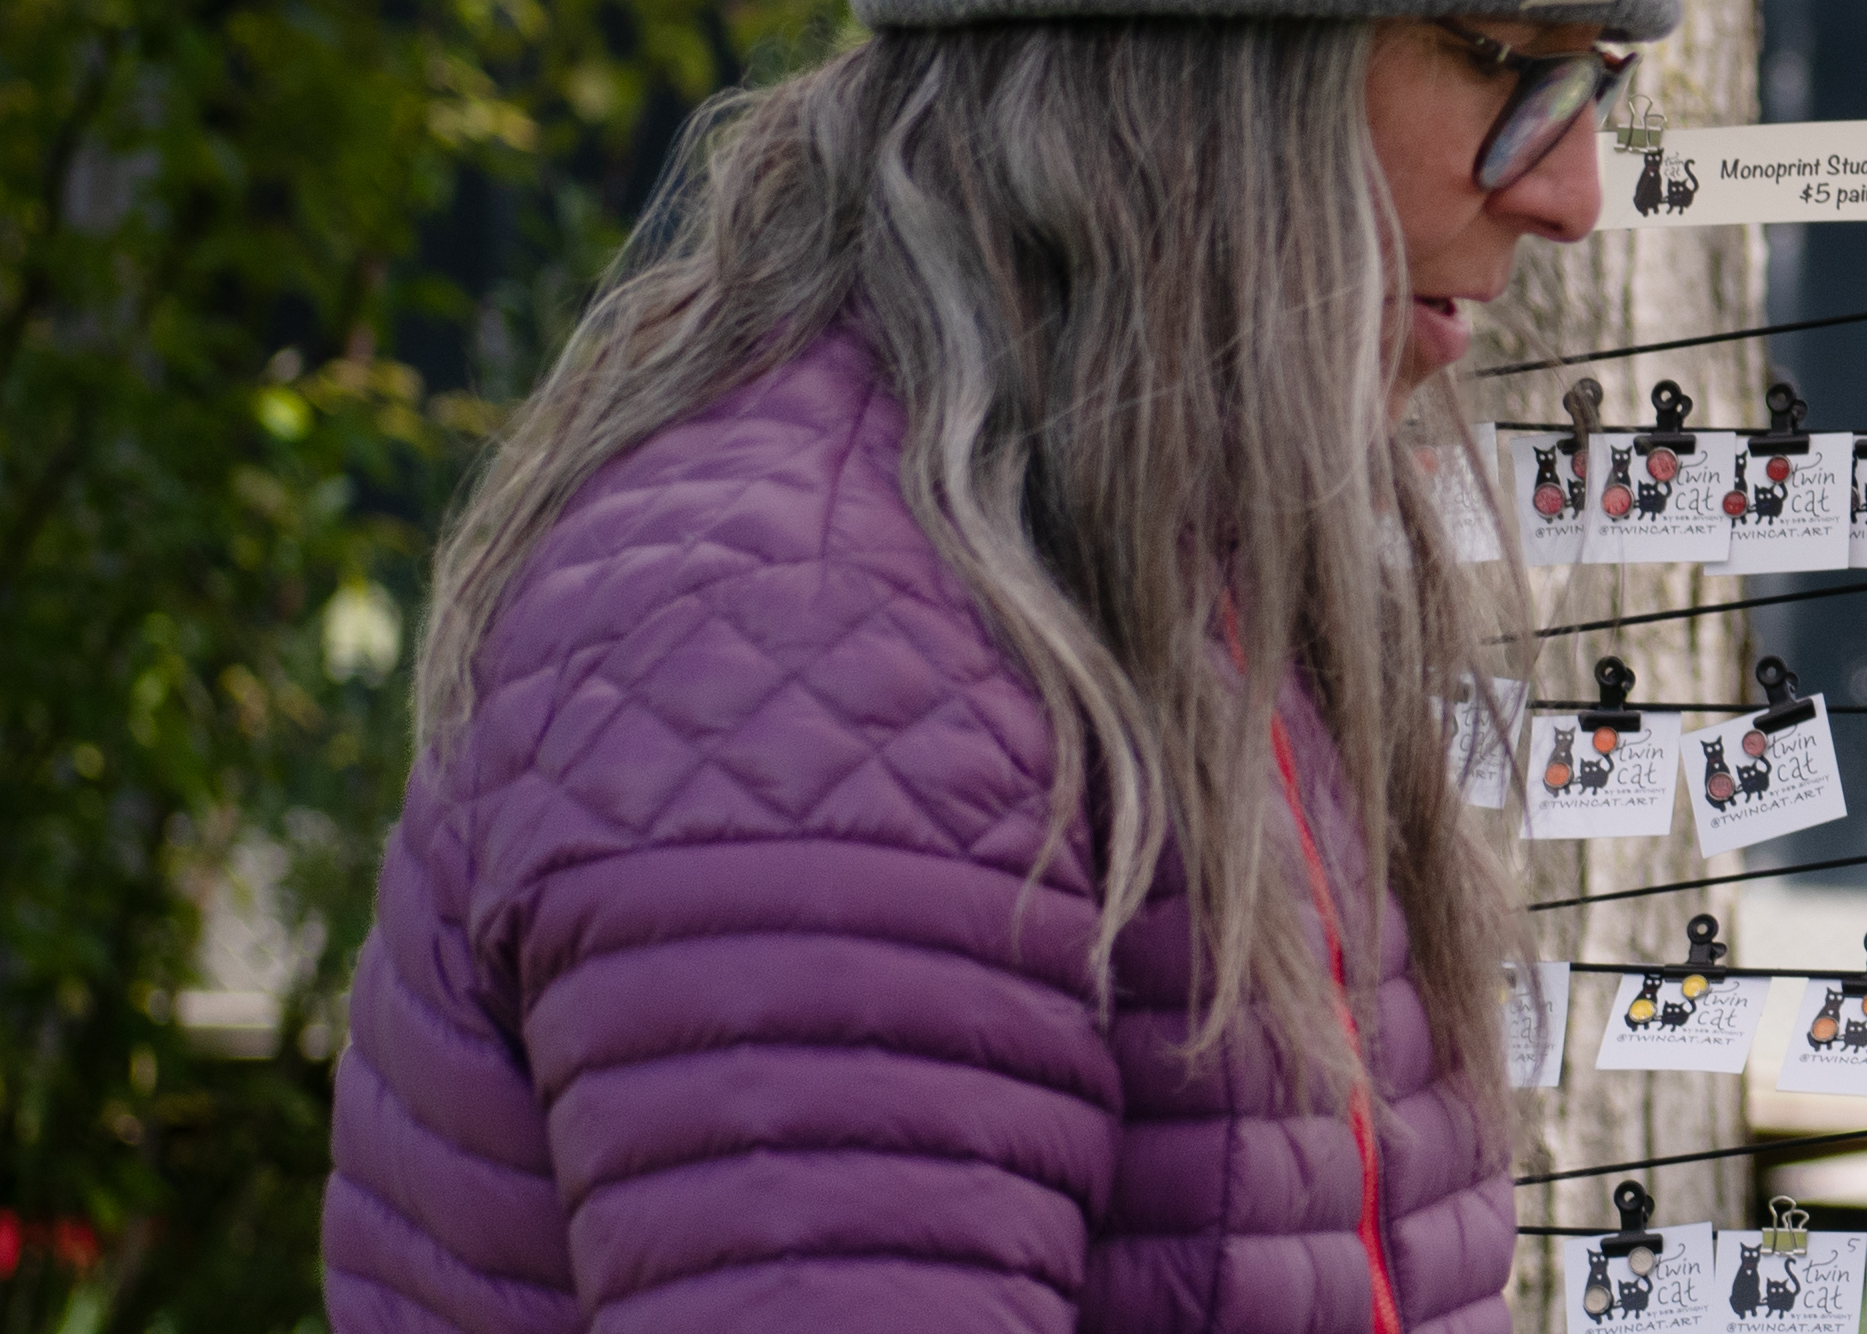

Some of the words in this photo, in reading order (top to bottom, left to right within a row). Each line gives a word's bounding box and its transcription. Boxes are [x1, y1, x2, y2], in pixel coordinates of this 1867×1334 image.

[1720, 158, 1821, 184] Monoprint
[1800, 183, 1831, 204] $5
[1672, 450, 1721, 486] twin
[1788, 451, 1836, 489] twin
[1674, 486, 1714, 516] cat
[1791, 487, 1830, 518] cat
[1599, 524, 1716, 536] @TWINCAT.ART
[1616, 729, 1664, 763] twin
[1767, 718, 1817, 760] twin
[1616, 761, 1657, 789] cat
[1776, 751, 1818, 783] cat
[1539, 796, 1658, 810] @TWINCAT.ART
[1710, 786, 1824, 829] @TWINCAT.ART
[1700, 980, 1748, 1007] twin
[1696, 1007, 1738, 1031] cat
[1615, 1032, 1735, 1045] @TWINCAT.ART
[1848, 1238, 1860, 1253] 5
[1651, 1242, 1701, 1281] twin
[1801, 1249, 1850, 1285] twin
[1657, 1277, 1698, 1308] cat
[1802, 1284, 1843, 1315] cat
[1726, 1322, 1844, 1333] @TWINCAT.ART
